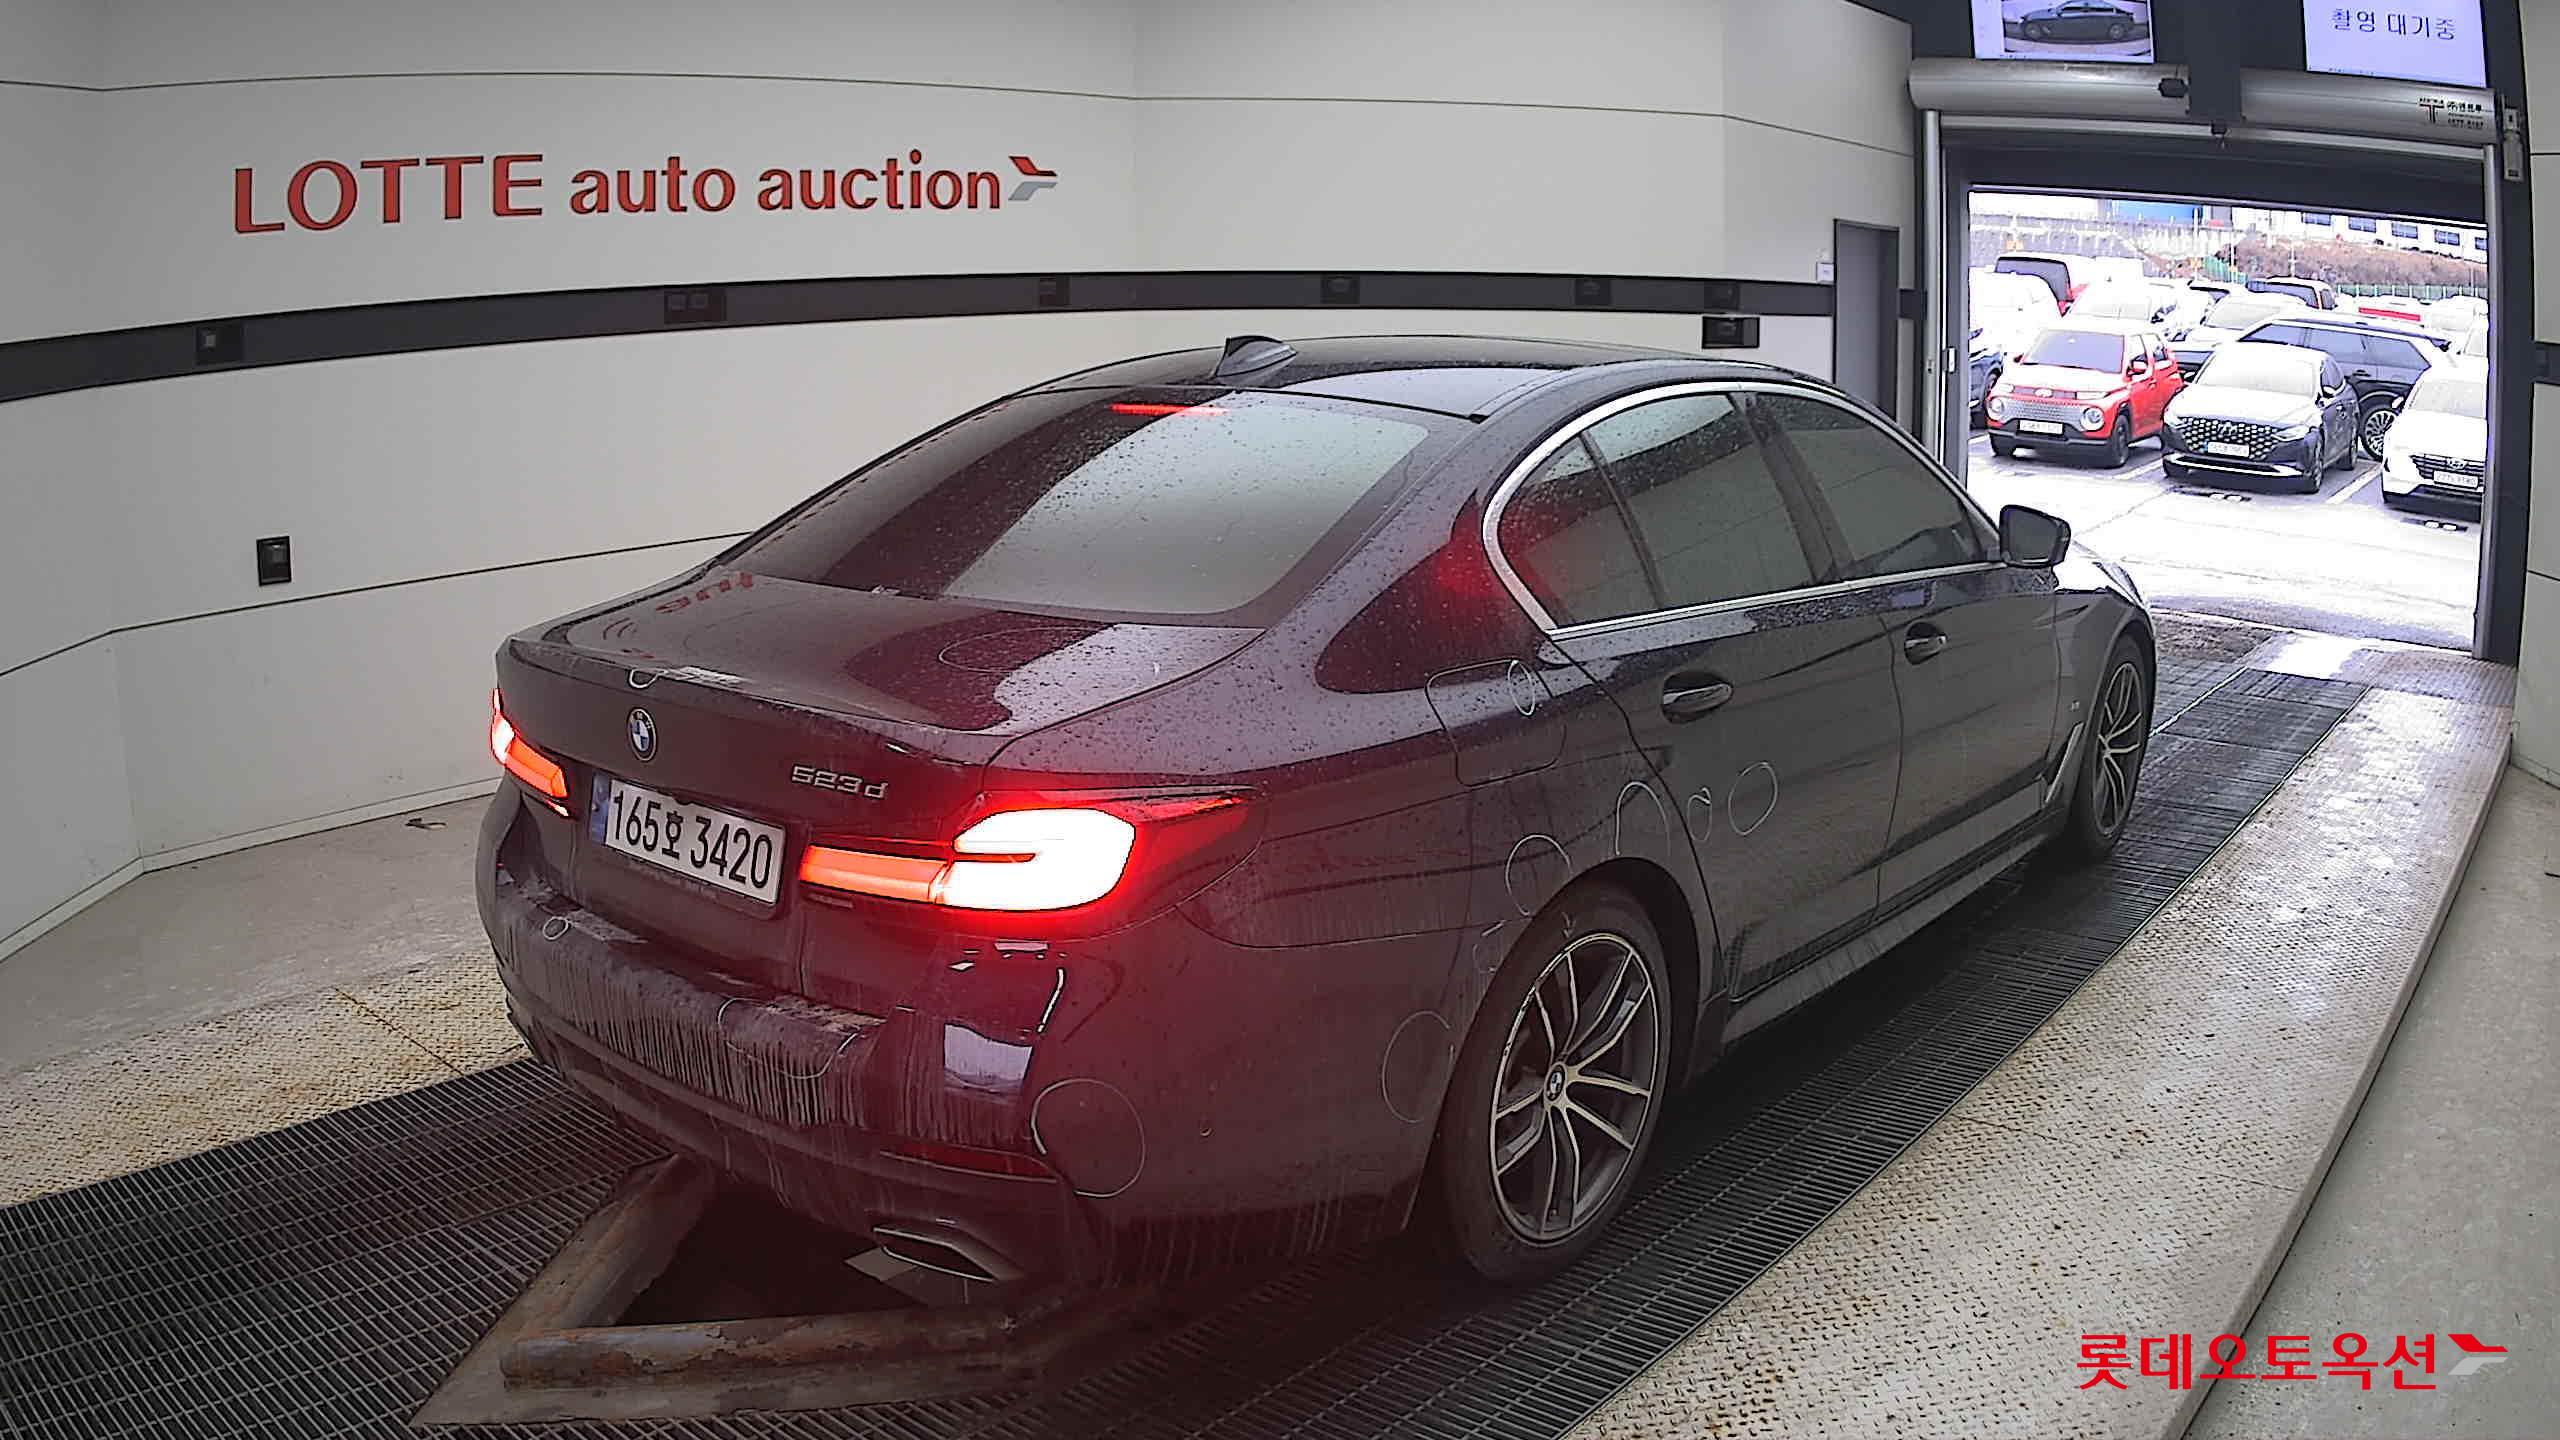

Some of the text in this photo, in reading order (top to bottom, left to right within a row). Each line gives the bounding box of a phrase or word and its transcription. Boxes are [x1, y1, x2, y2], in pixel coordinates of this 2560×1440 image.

[2332, 9, 2455, 40] 촬영 대기중
[235, 149, 1000, 234] LOTTE auto auction
[791, 764, 889, 799] 523d
[690, 815, 773, 889] 3420
